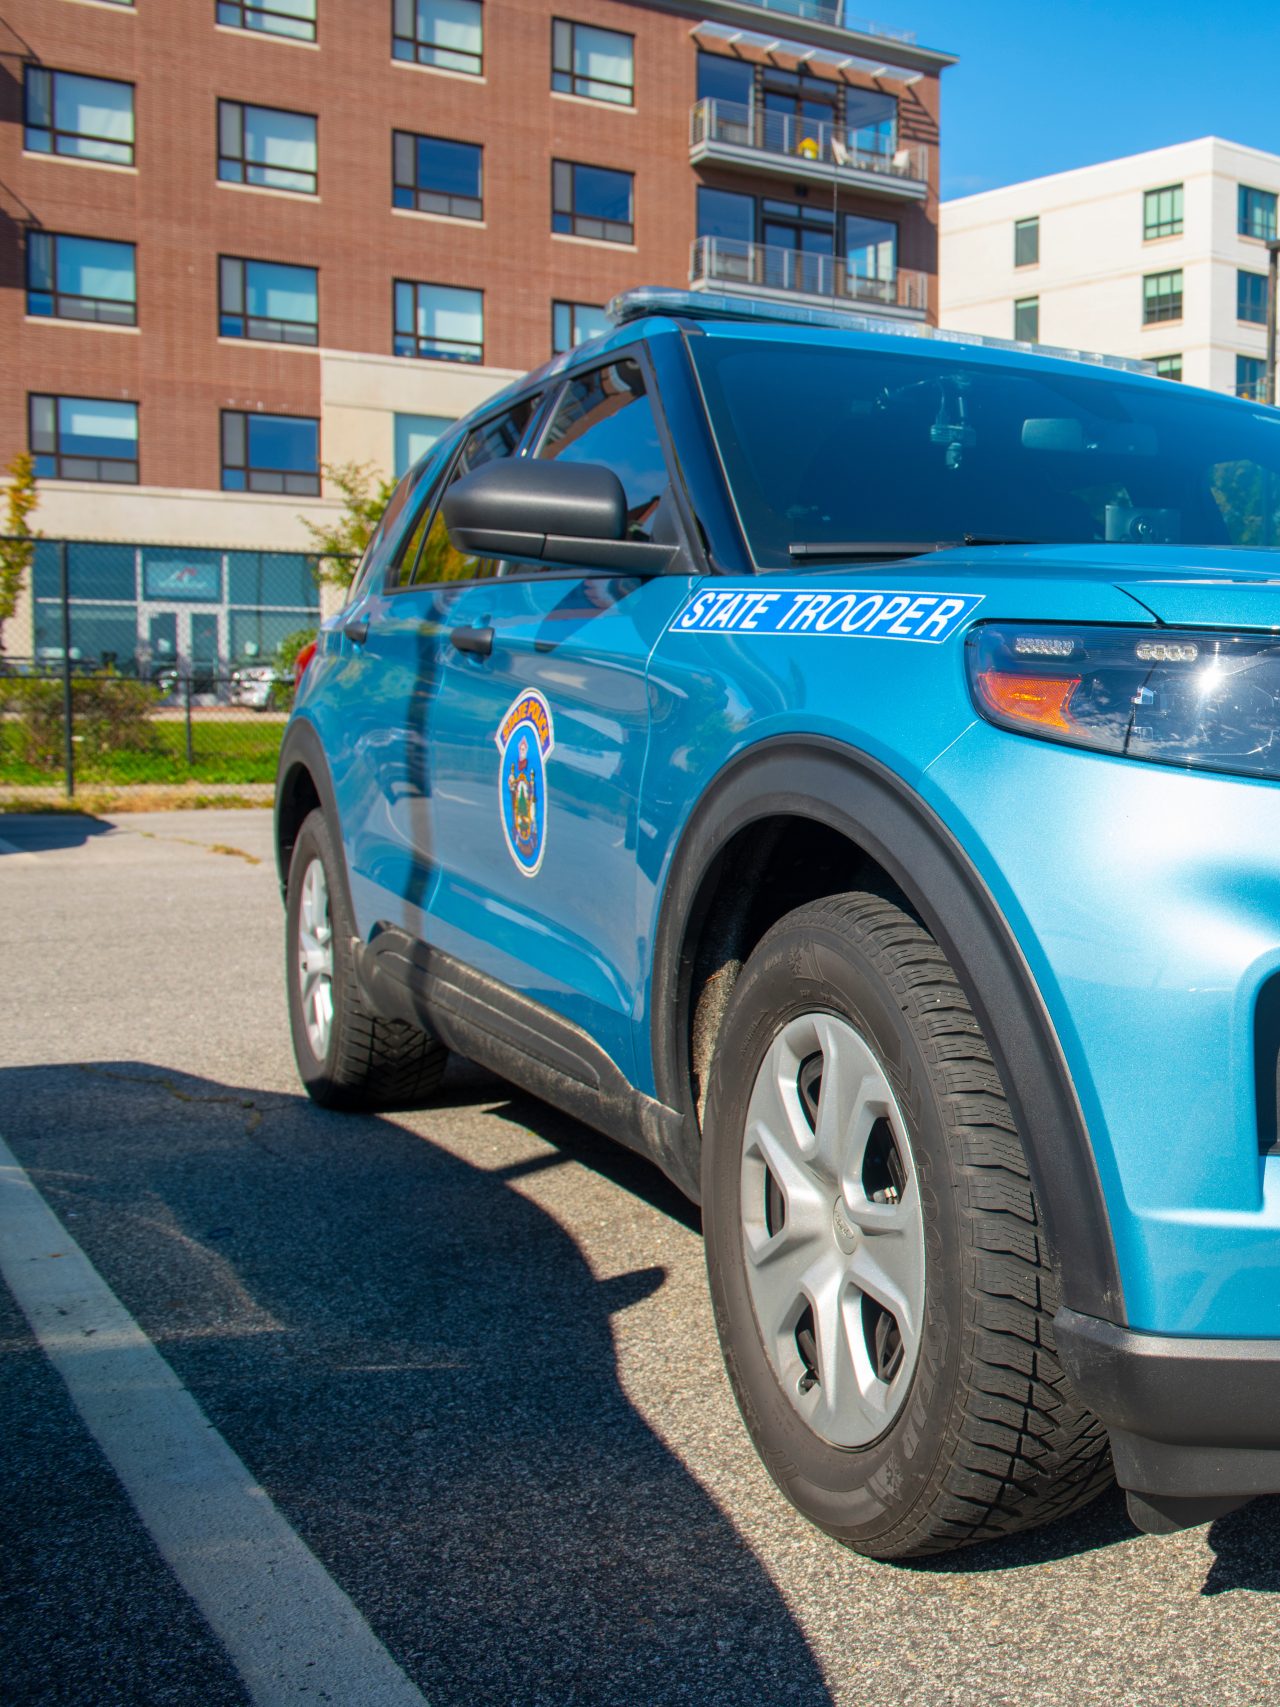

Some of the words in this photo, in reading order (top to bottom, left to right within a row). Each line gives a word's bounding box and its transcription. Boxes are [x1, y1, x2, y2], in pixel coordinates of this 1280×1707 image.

[681, 592, 781, 629] STATE
[775, 594, 965, 637] TROOPER
[502, 701, 529, 741] STATE
[528, 700, 549, 747] POLICE
